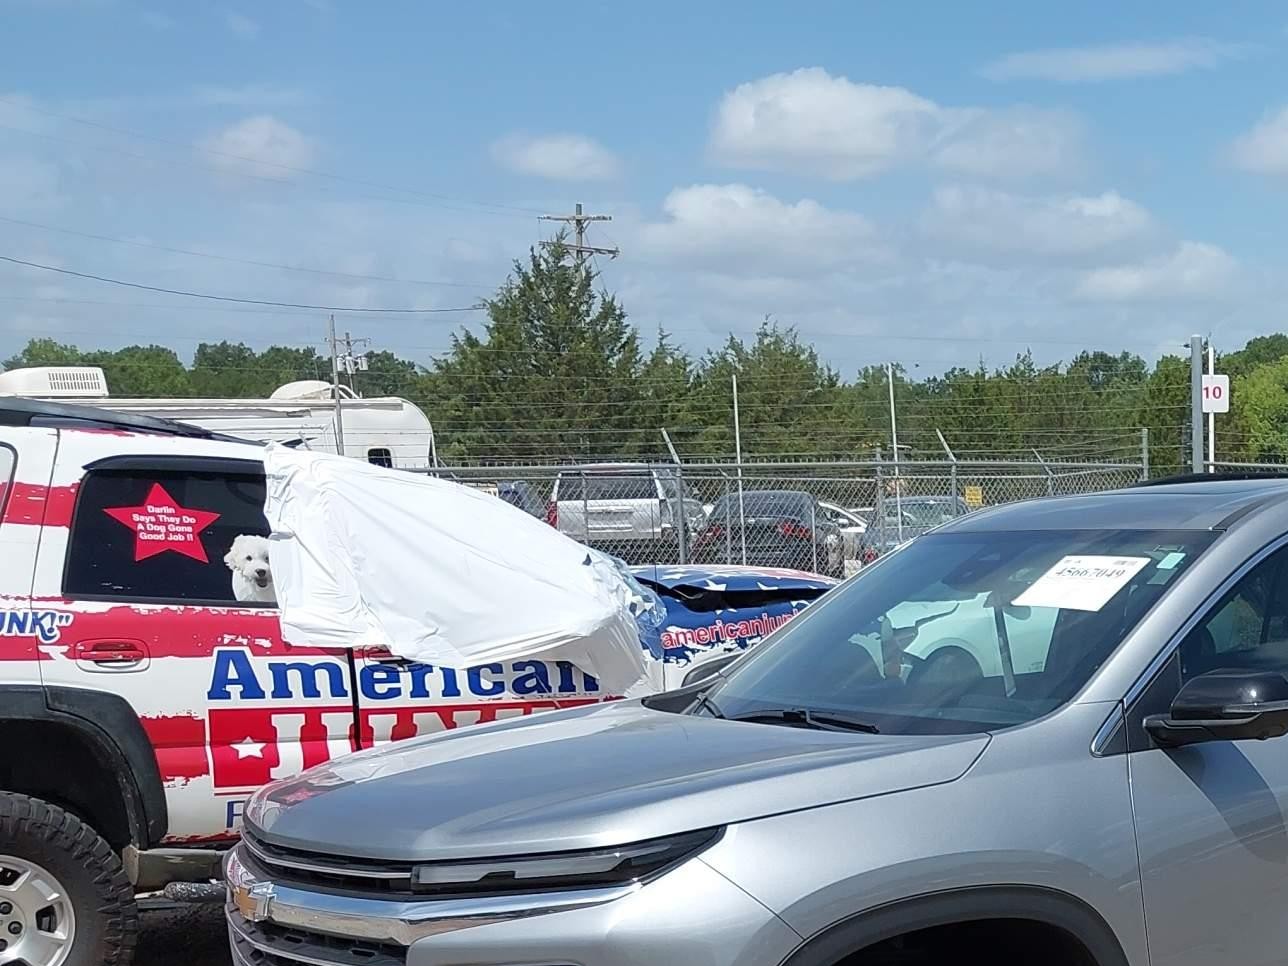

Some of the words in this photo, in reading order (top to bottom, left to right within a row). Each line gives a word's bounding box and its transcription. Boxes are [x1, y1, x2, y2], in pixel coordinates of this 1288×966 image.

[1203, 386, 1222, 400] 10
[146, 505, 176, 514] Darlin
[132, 513, 156, 524] Says
[157, 514, 180, 524] They
[182, 515, 197, 524] Do
[146, 523, 166, 533] Dog
[167, 524, 193, 532] Gone
[139, 532, 165, 541] Good
[167, 533, 185, 541] Job
[207, 649, 600, 700] American
